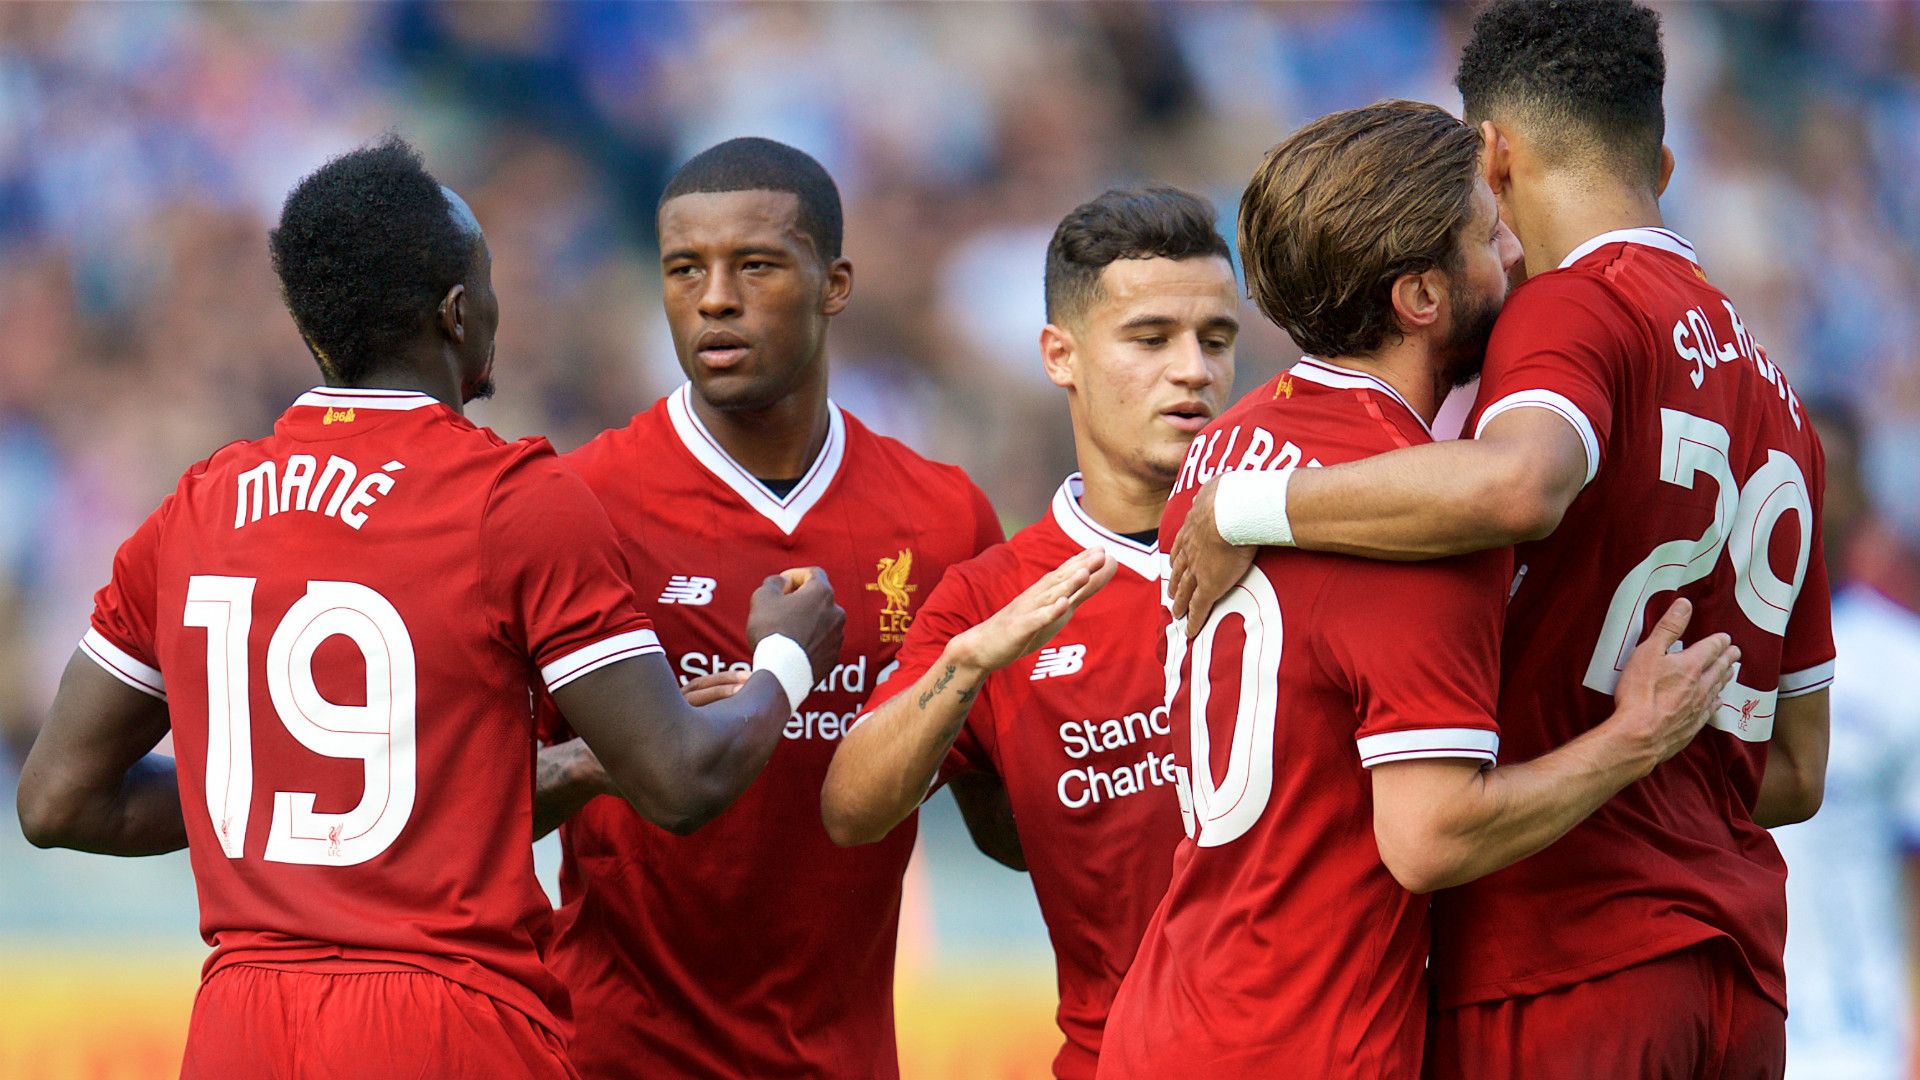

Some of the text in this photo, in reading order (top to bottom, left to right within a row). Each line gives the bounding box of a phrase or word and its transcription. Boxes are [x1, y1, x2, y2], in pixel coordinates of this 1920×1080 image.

[235, 454, 405, 530] MANÉ
[1583, 408, 1813, 742] 29
[880, 614, 913, 632] LFC
[183, 575, 416, 866] 19
[1057, 752, 1177, 808] Charte
